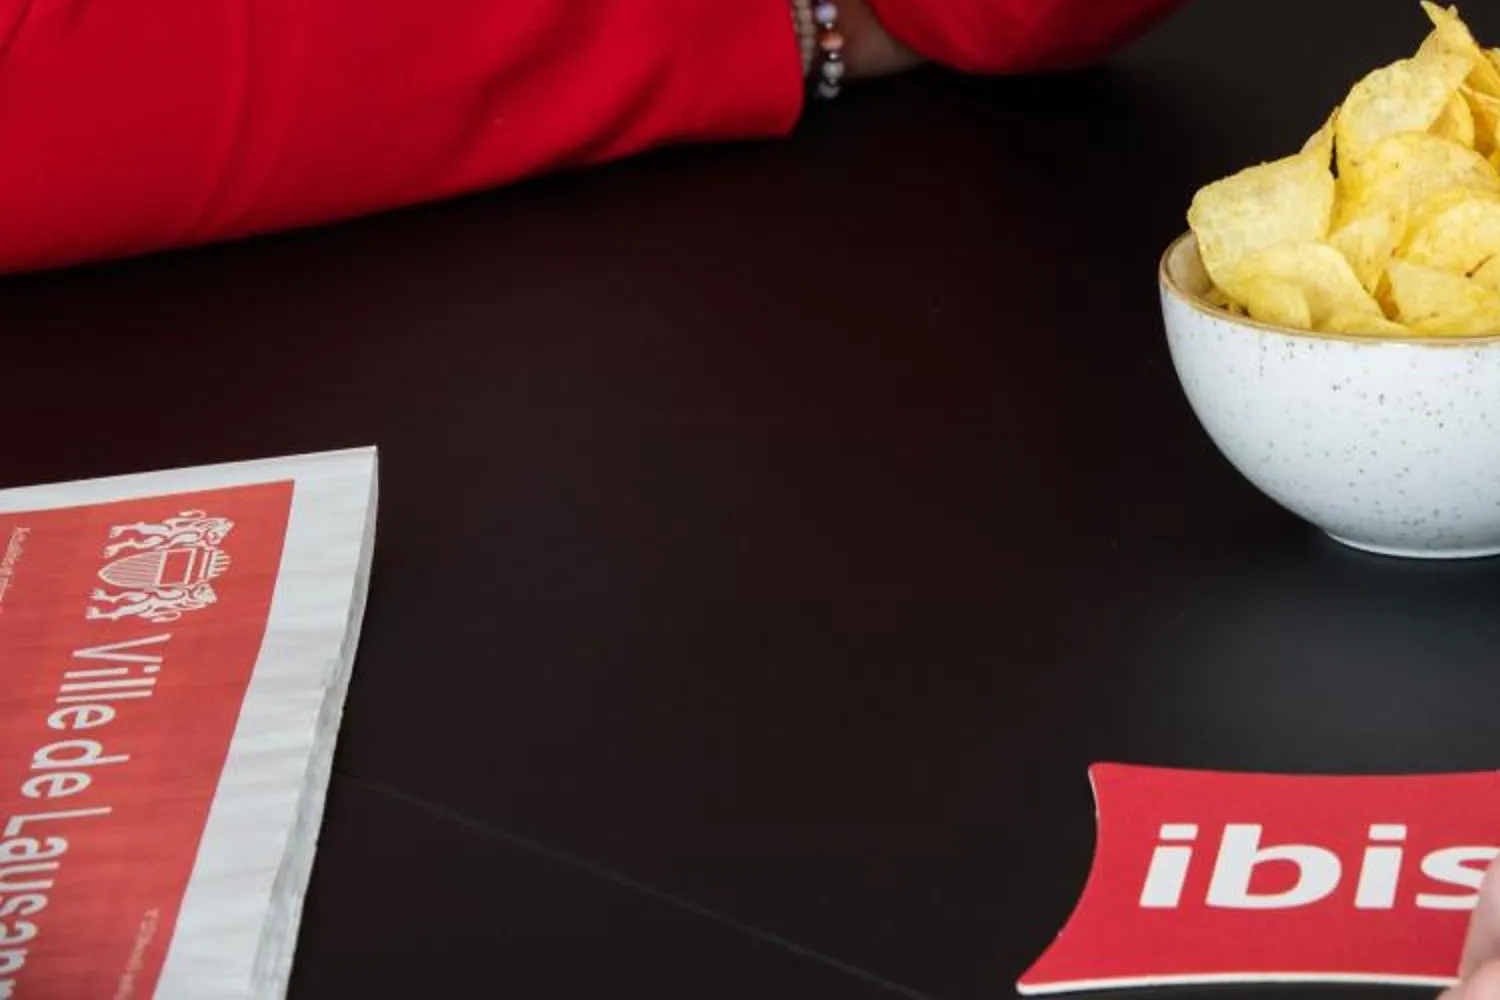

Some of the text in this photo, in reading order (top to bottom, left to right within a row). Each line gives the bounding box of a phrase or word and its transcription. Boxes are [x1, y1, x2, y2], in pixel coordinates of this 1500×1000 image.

[0, 633, 171, 1000] Ville de Lausa
